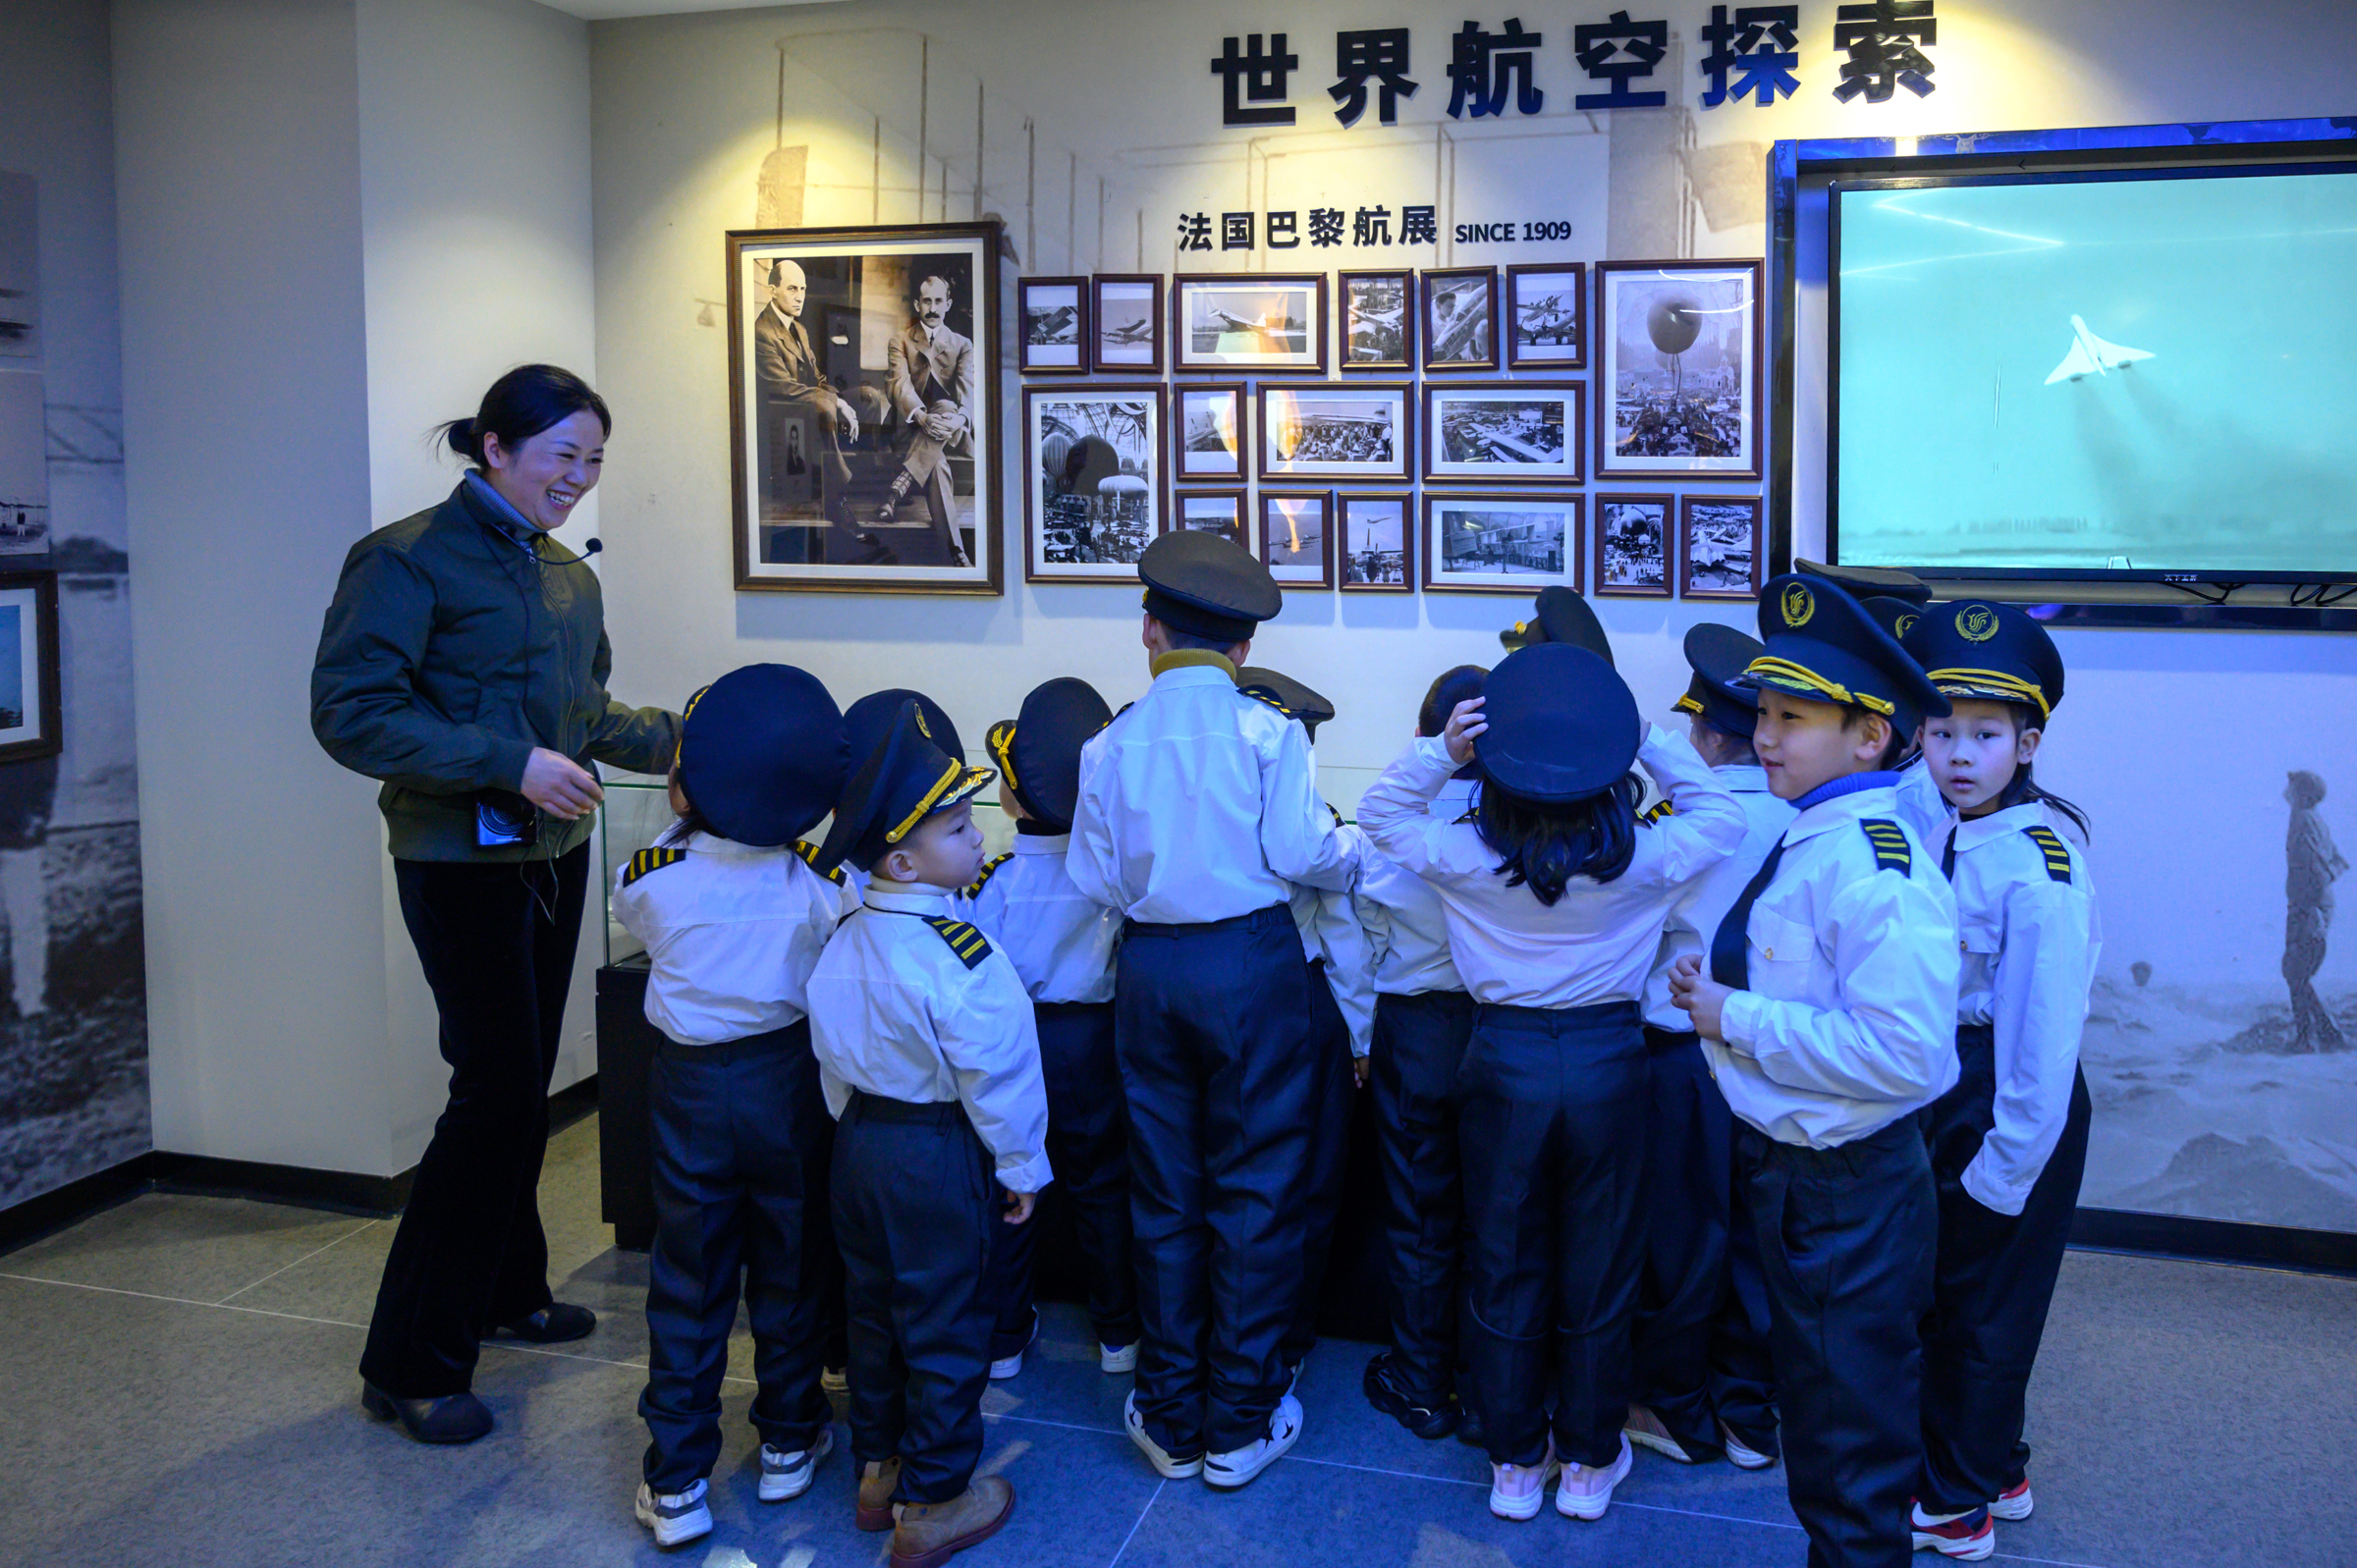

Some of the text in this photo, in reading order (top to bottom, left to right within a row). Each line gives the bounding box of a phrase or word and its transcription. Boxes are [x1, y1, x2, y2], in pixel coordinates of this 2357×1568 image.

[1210, 0, 1937, 127] 世界航空探索
[1178, 205, 1437, 251] 法国巴黎航展
[1454, 221, 1571, 243] SINCE 1909
